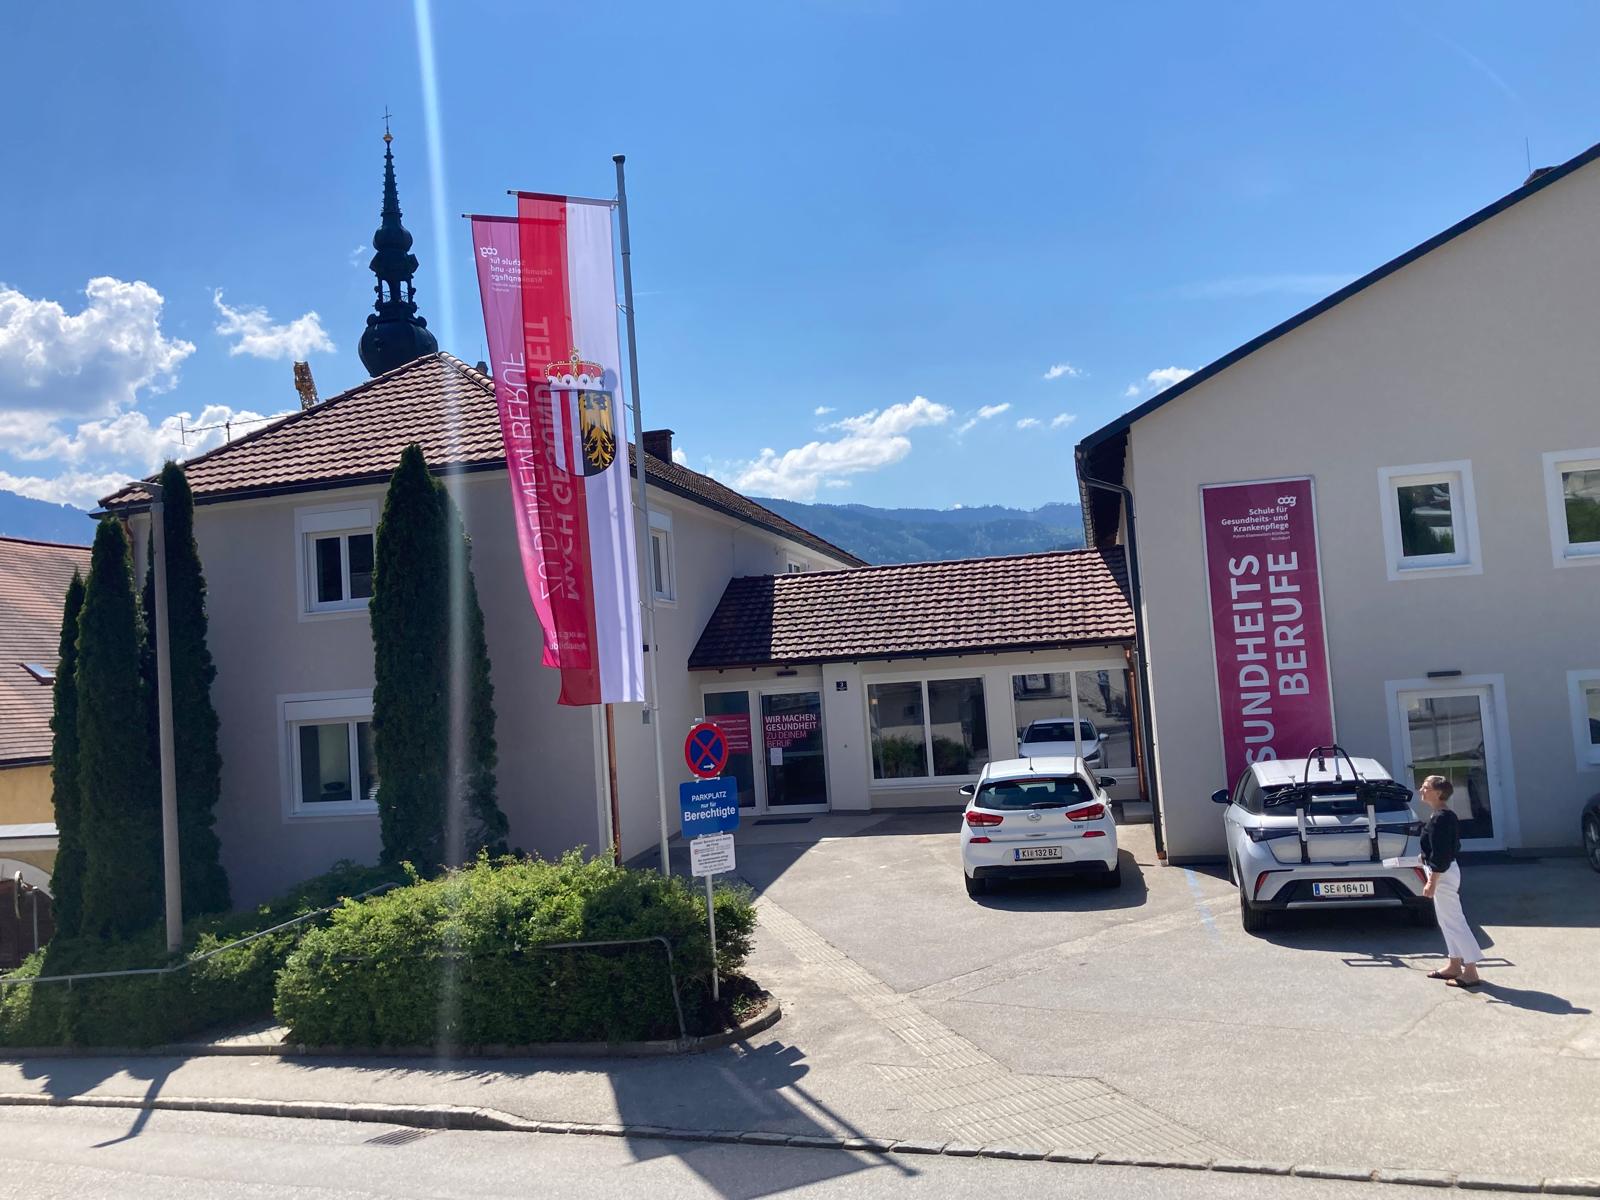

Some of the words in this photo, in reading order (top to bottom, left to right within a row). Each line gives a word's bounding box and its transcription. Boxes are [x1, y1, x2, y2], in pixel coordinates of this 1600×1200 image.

[1248, 507, 1275, 515] Schule
[1221, 516, 1272, 526] Gesundheits-
[1233, 522, 1289, 532] Krankenpflege
[1267, 552, 1310, 696] BERUFE
[1228, 554, 1277, 766] SUNDHEITS
[782, 714, 816, 722] MACHEN
[766, 722, 816, 731] GESUNDHEIT
[779, 730, 806, 739] DEINEM
[767, 739, 792, 748] BERUF
[692, 791, 727, 802] PARKPLATZ
[684, 806, 736, 821] Berechtigte
[1022, 850, 1030, 858] KI
[1048, 848, 1057, 856] BZ
[1324, 884, 1335, 893] SE
[1343, 884, 1357, 893] 164
[1359, 884, 1368, 892] DI
